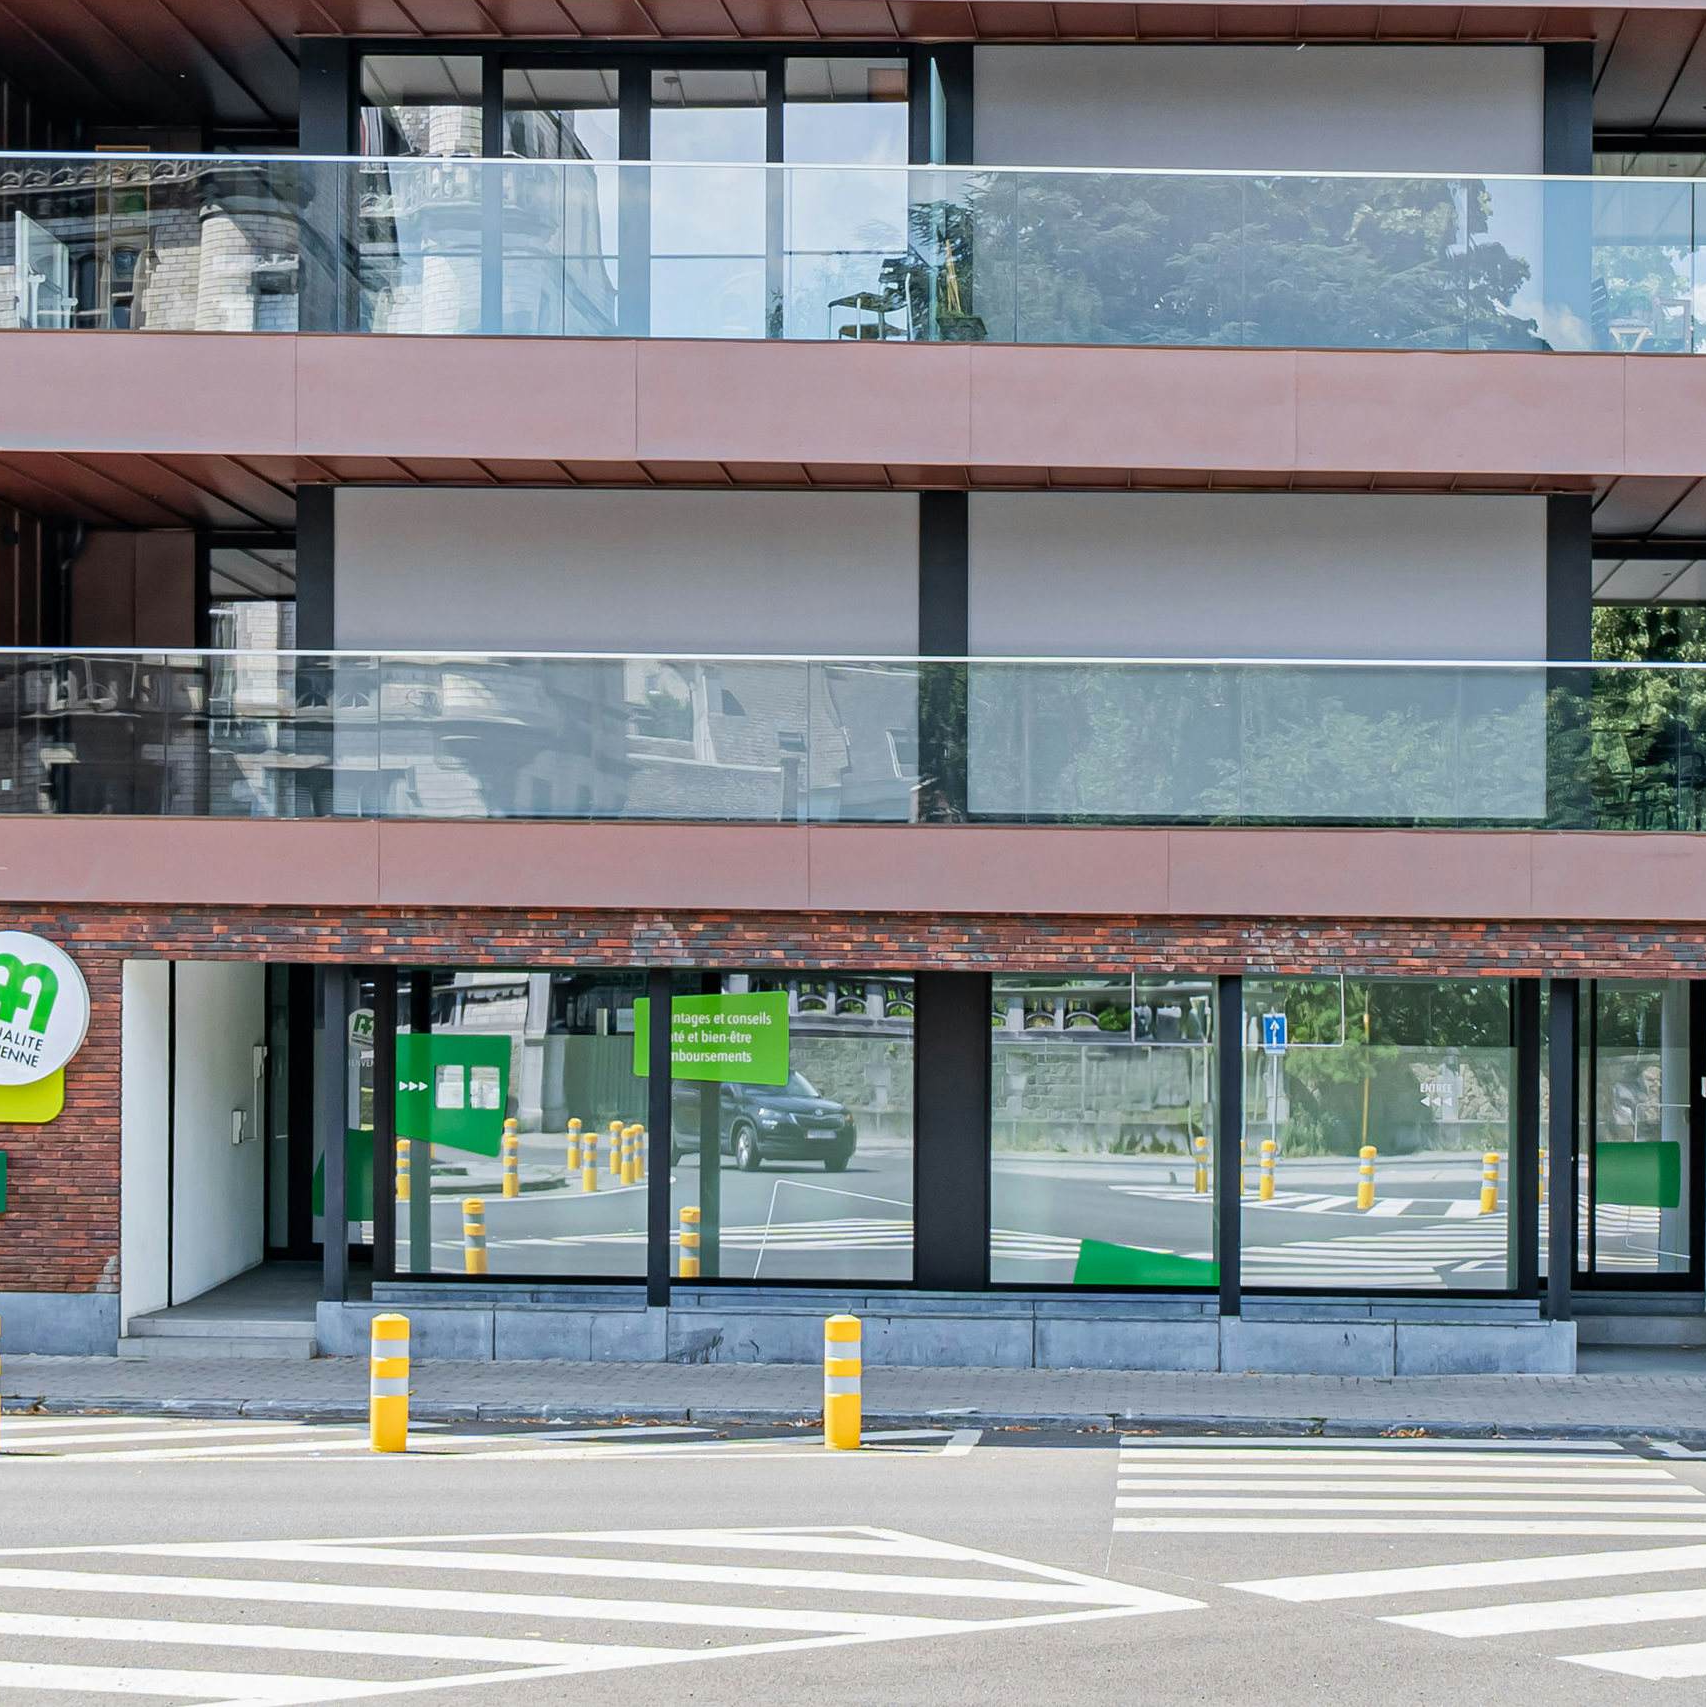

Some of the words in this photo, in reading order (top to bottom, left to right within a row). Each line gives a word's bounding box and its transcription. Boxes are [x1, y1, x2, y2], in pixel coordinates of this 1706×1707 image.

[713, 1013, 725, 1025] et
[727, 1011, 772, 1026] conseils
[688, 1032, 698, 1043] et
[701, 1030, 752, 1044] bien-être
